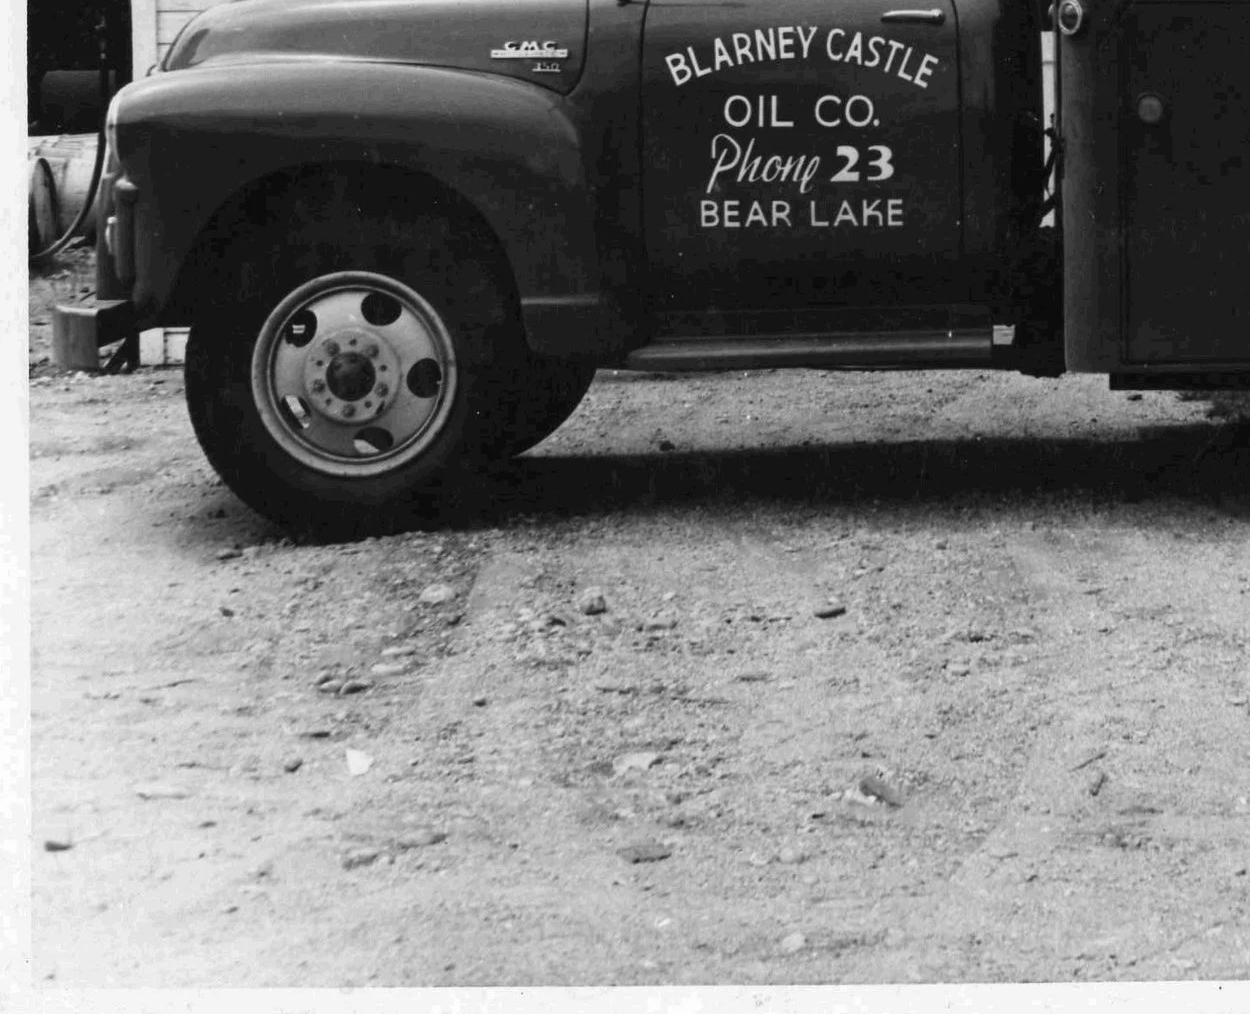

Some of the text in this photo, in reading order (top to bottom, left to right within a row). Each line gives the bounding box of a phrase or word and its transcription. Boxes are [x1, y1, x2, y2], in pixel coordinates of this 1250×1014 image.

[664, 25, 939, 89] BLARNEY CASTLE
[724, 94, 880, 128] OIL CO.
[706, 133, 895, 194] Phone 23
[700, 198, 904, 228] BEAR LAKE
